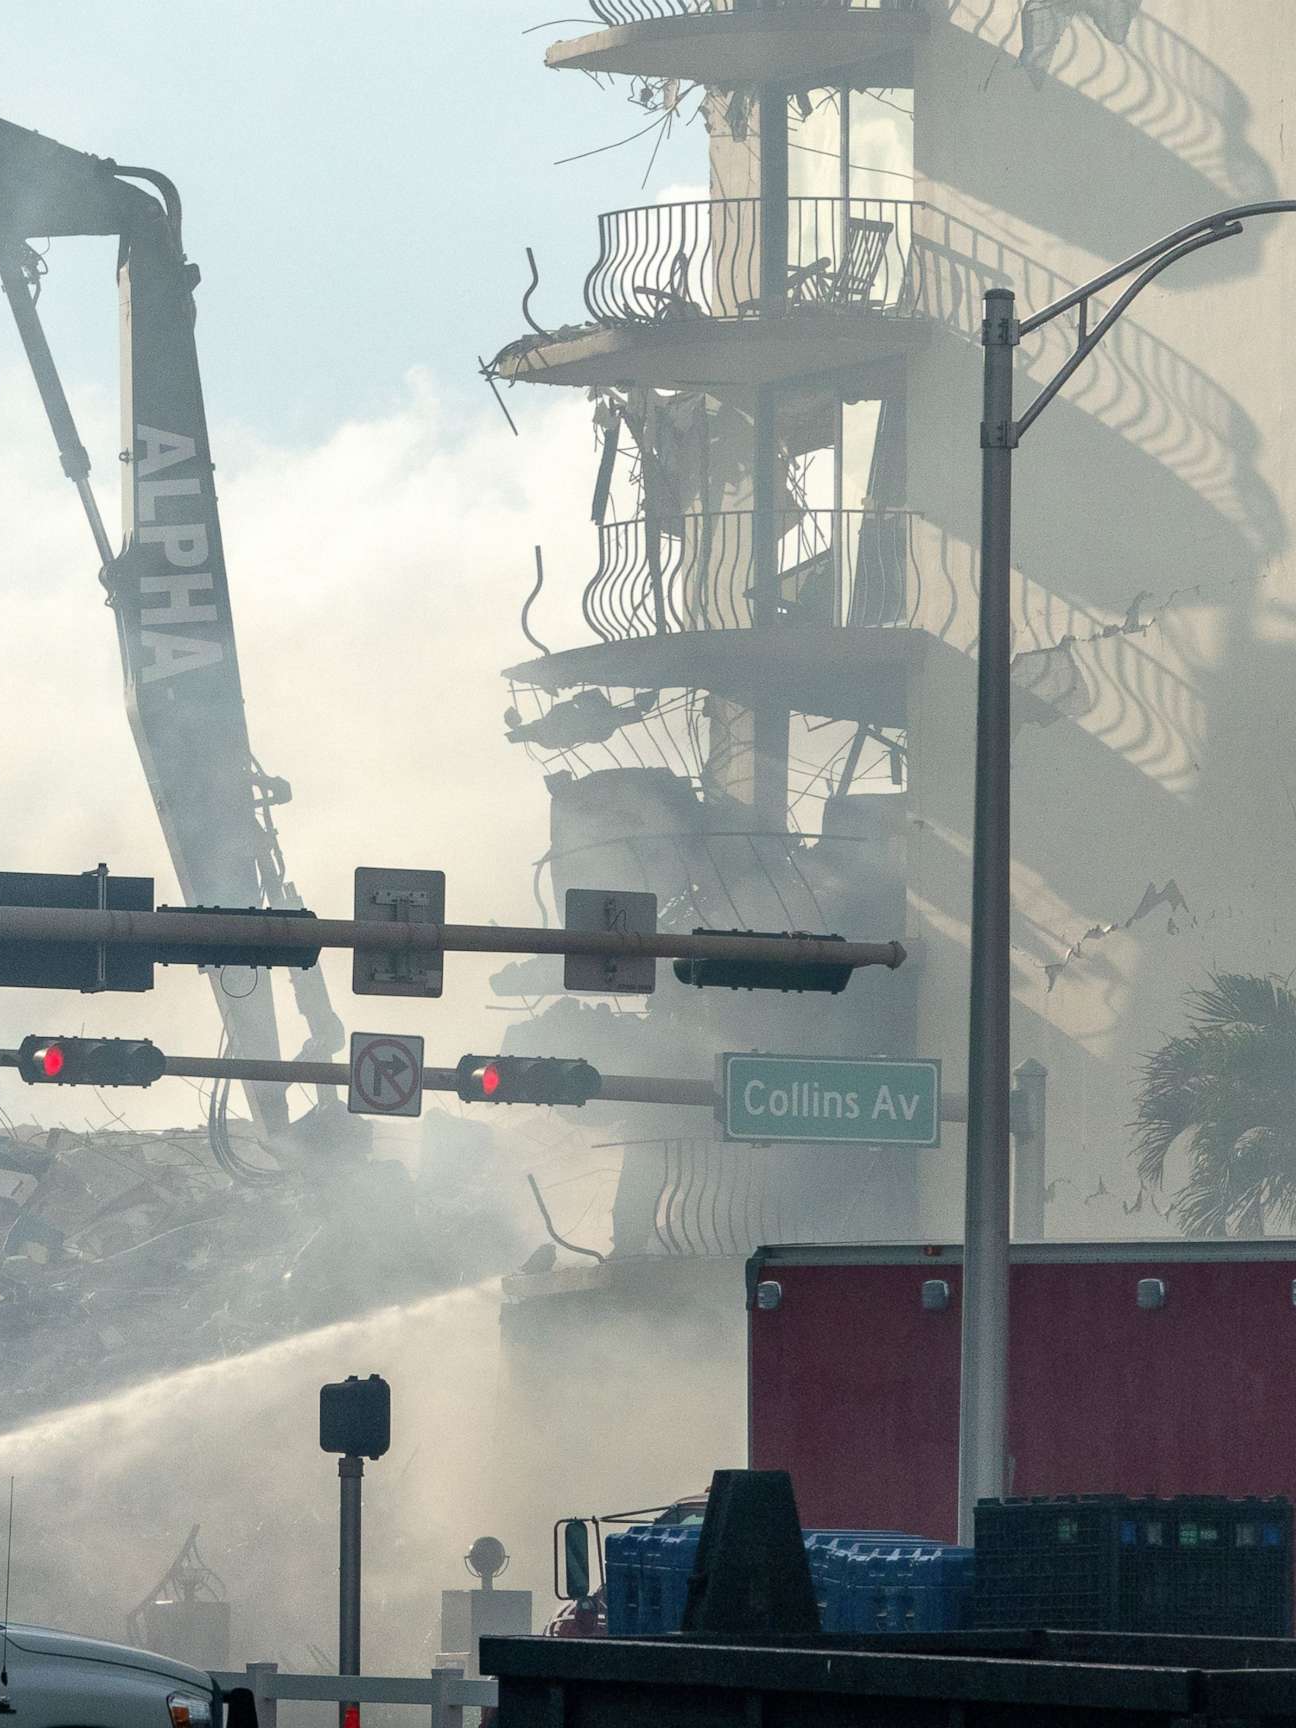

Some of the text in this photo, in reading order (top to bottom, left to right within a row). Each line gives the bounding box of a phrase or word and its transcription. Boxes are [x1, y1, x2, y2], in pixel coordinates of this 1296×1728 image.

[136, 423, 224, 685] ALPHA
[743, 1079, 920, 1121] Collins Av
